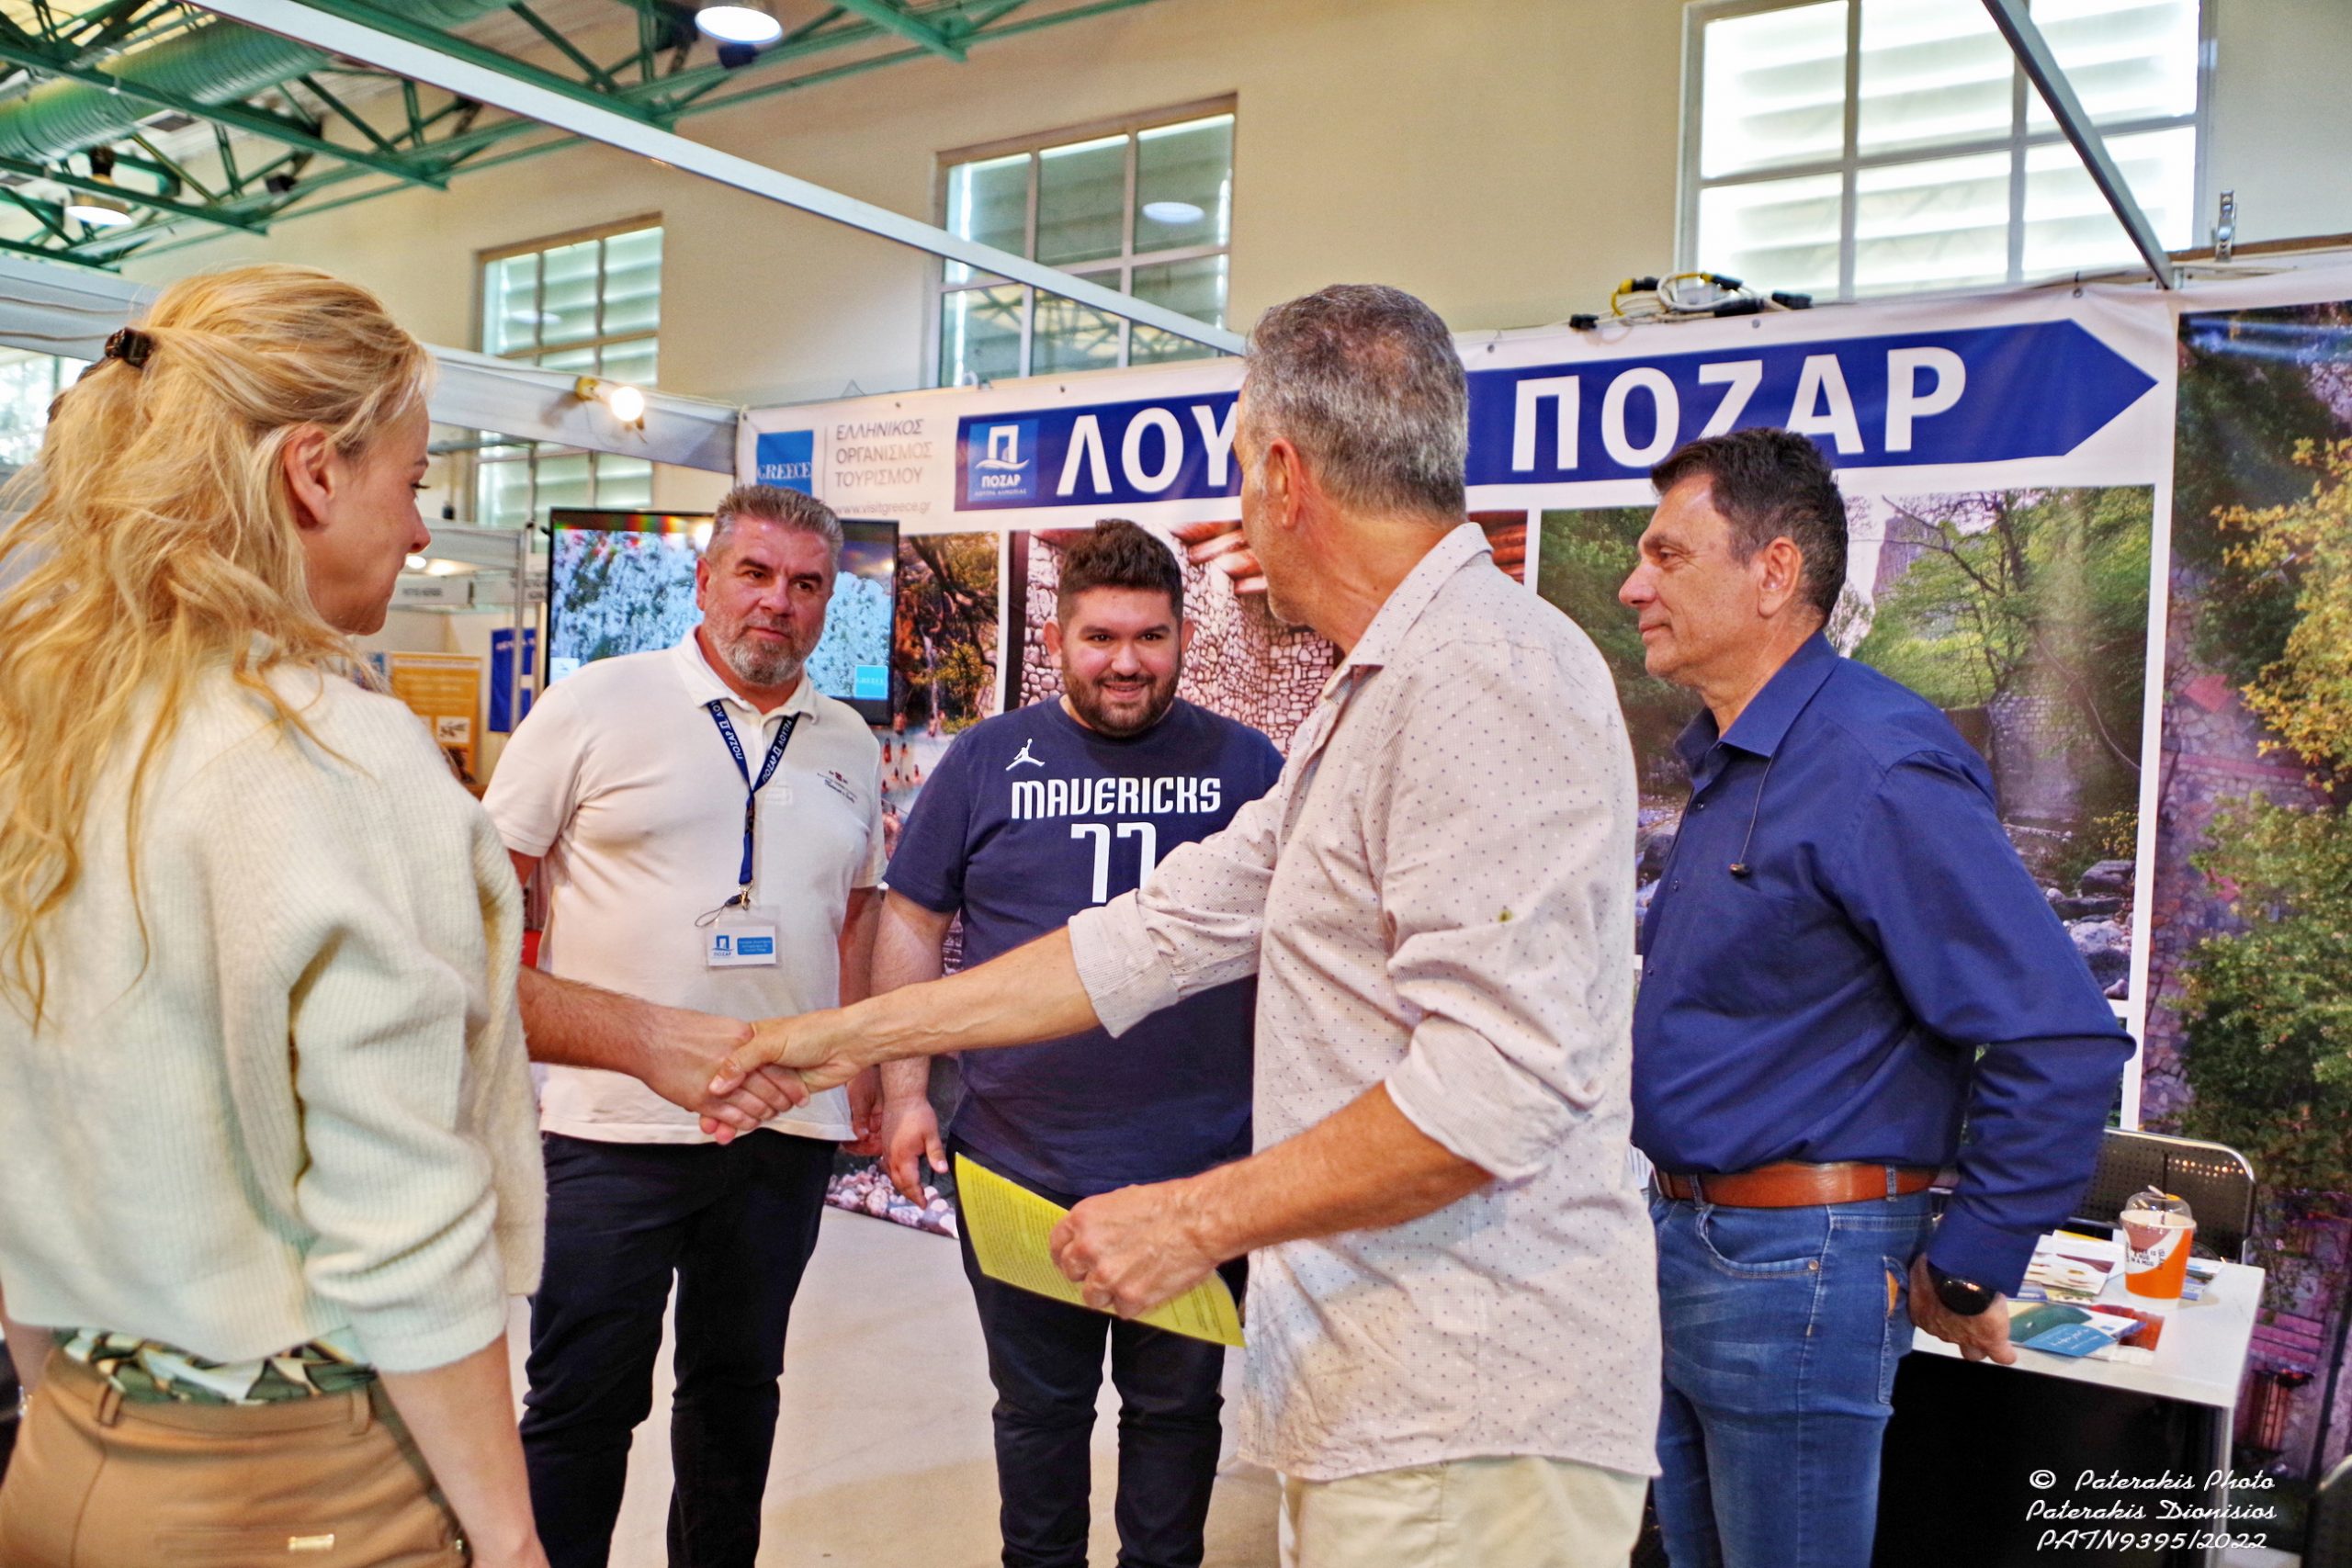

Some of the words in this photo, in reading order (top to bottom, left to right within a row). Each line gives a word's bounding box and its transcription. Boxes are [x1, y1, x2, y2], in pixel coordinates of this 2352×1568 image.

[1511, 346, 1966, 472] ΠΟΖΑΡ
[835, 419, 924, 441] ΕΛΛΗΝΙΚΟΣ
[835, 442, 933, 465] ΟΡΓΑΝΙΣΜΟΣ
[758, 461, 812, 479] GREECE
[835, 467, 923, 488] ΤΟΥΡΙΣΜΟΥ
[980, 473, 1022, 489] ΠΟΖΑΡ
[725, 731, 743, 760] ΠΟΖΑΡ
[1012, 776, 1221, 819] MAVERICKS
[1070, 821, 1157, 904] 77
